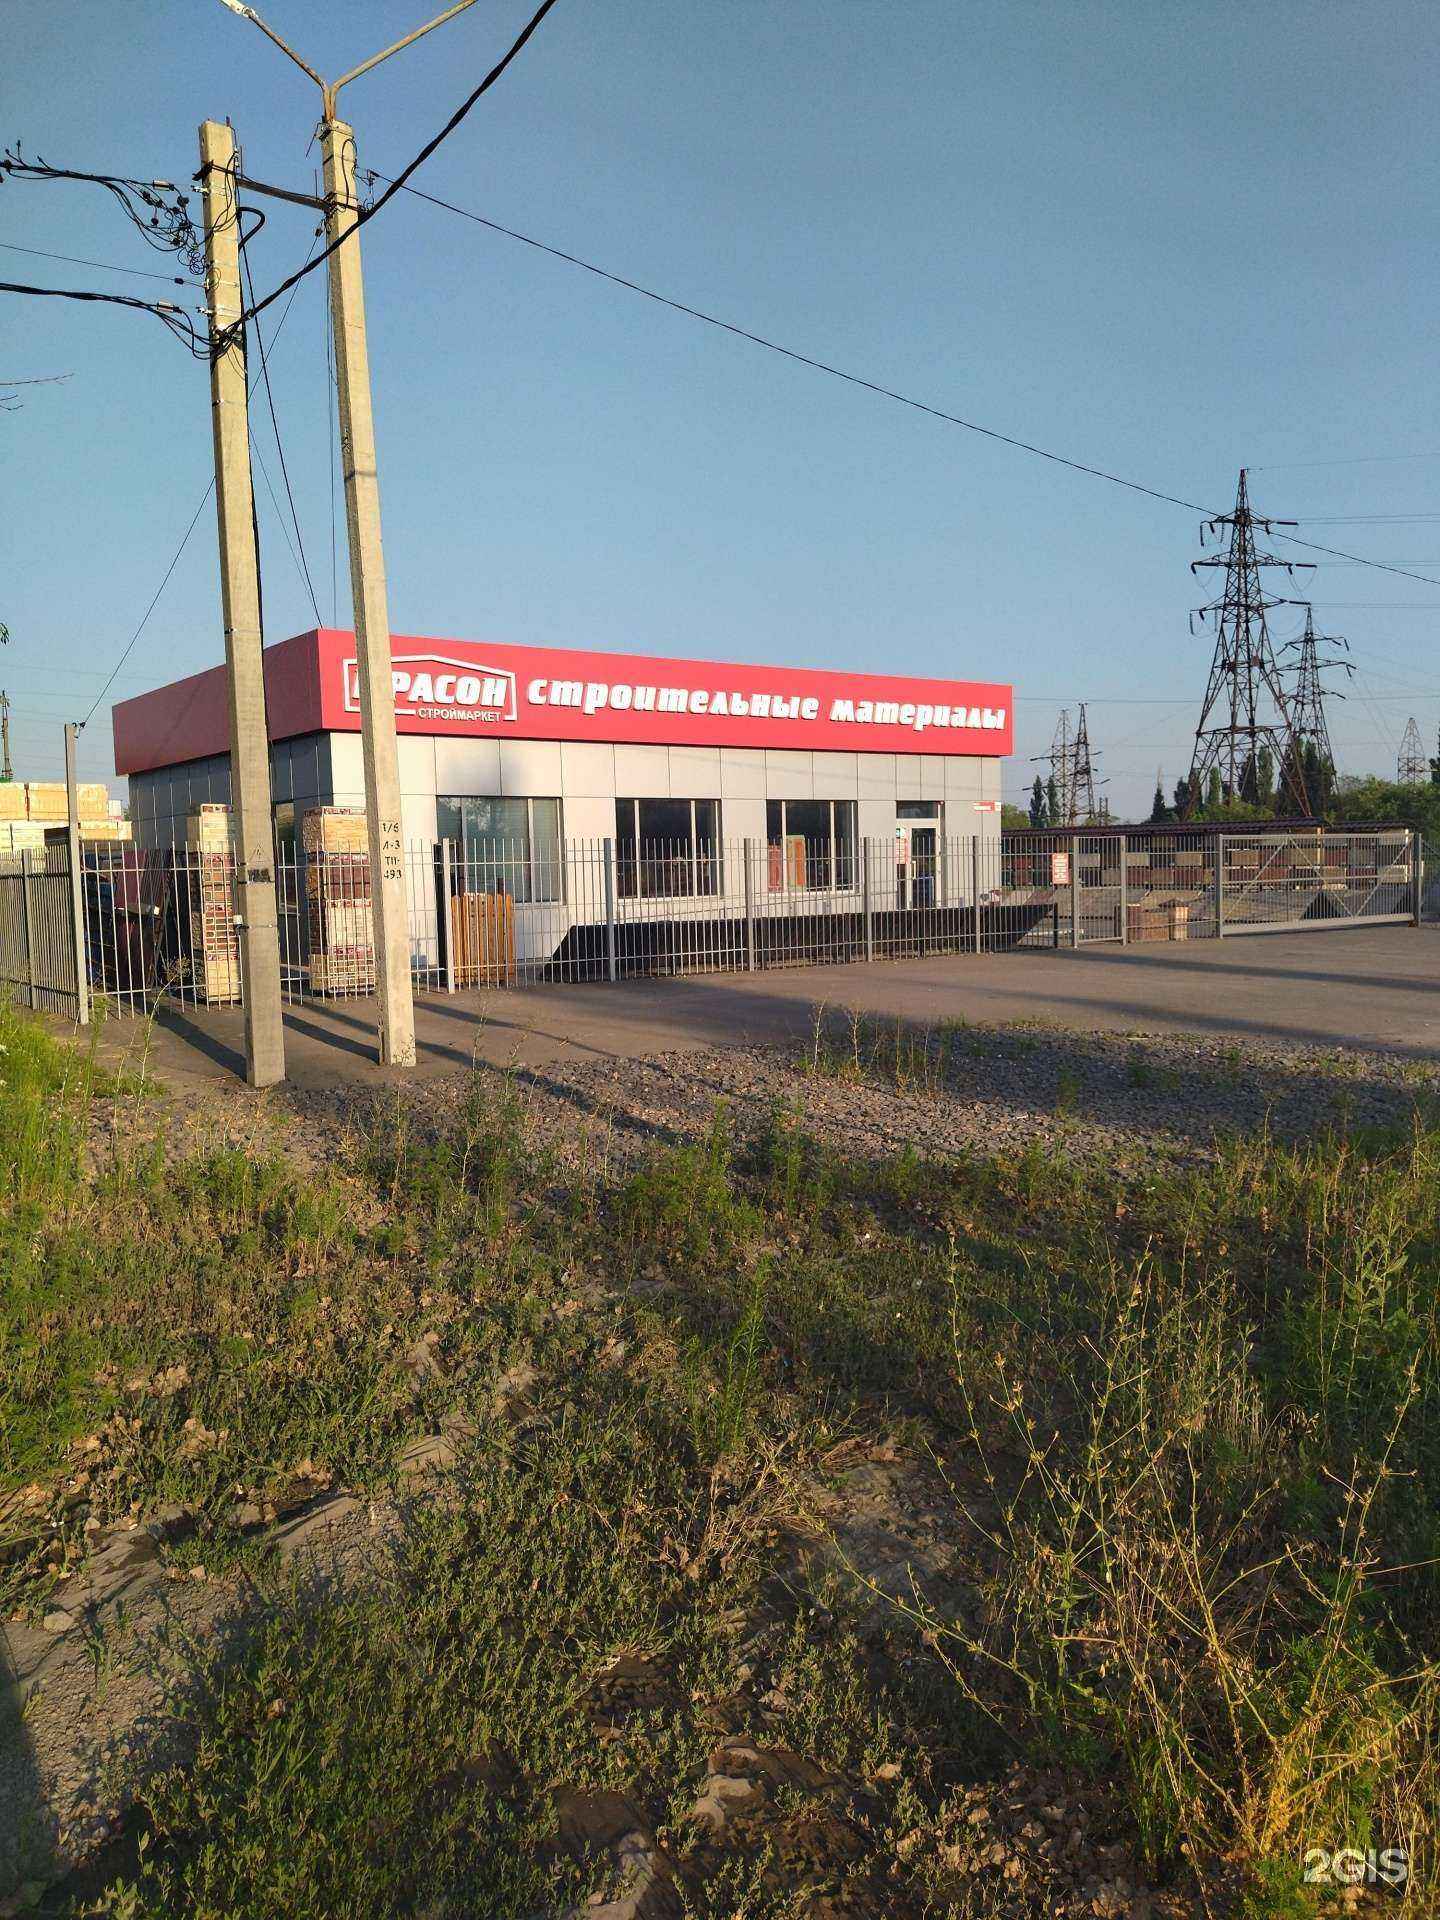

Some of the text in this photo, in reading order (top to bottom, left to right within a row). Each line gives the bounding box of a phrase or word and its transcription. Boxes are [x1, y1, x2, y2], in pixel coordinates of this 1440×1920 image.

[352, 671, 508, 707] РАСОН
[527, 679, 1006, 732] строительные материалы
[418, 707, 501, 722] СТРОЙМАРКЕТ
